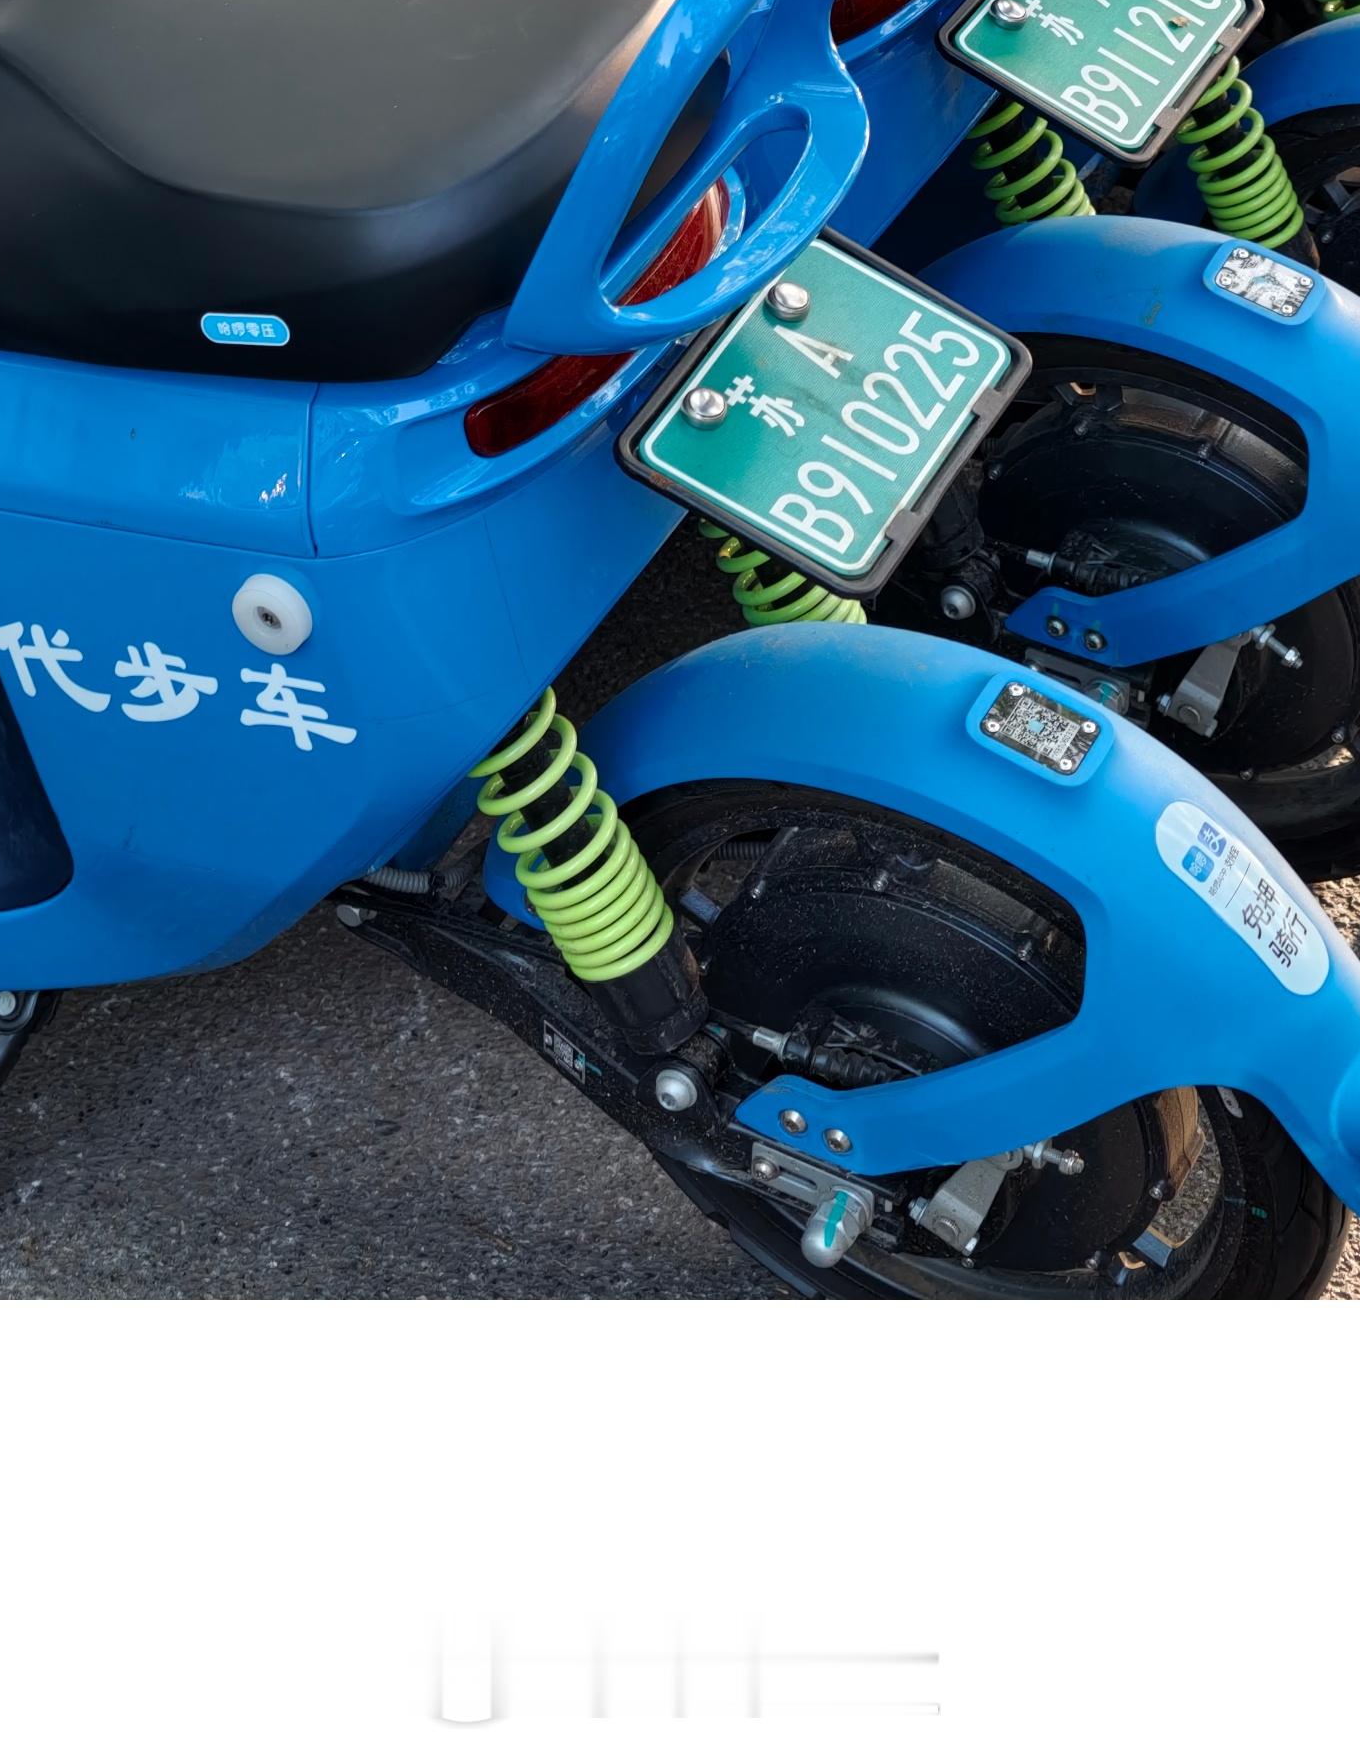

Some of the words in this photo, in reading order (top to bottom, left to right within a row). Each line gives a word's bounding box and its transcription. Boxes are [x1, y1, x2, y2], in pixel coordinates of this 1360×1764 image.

[725, 375, 805, 436] 苏
[773, 325, 854, 379] A
[769, 310, 980, 554] B910225
[1242, 878, 1280, 940] 免押
[1269, 907, 1308, 968] 骑行
